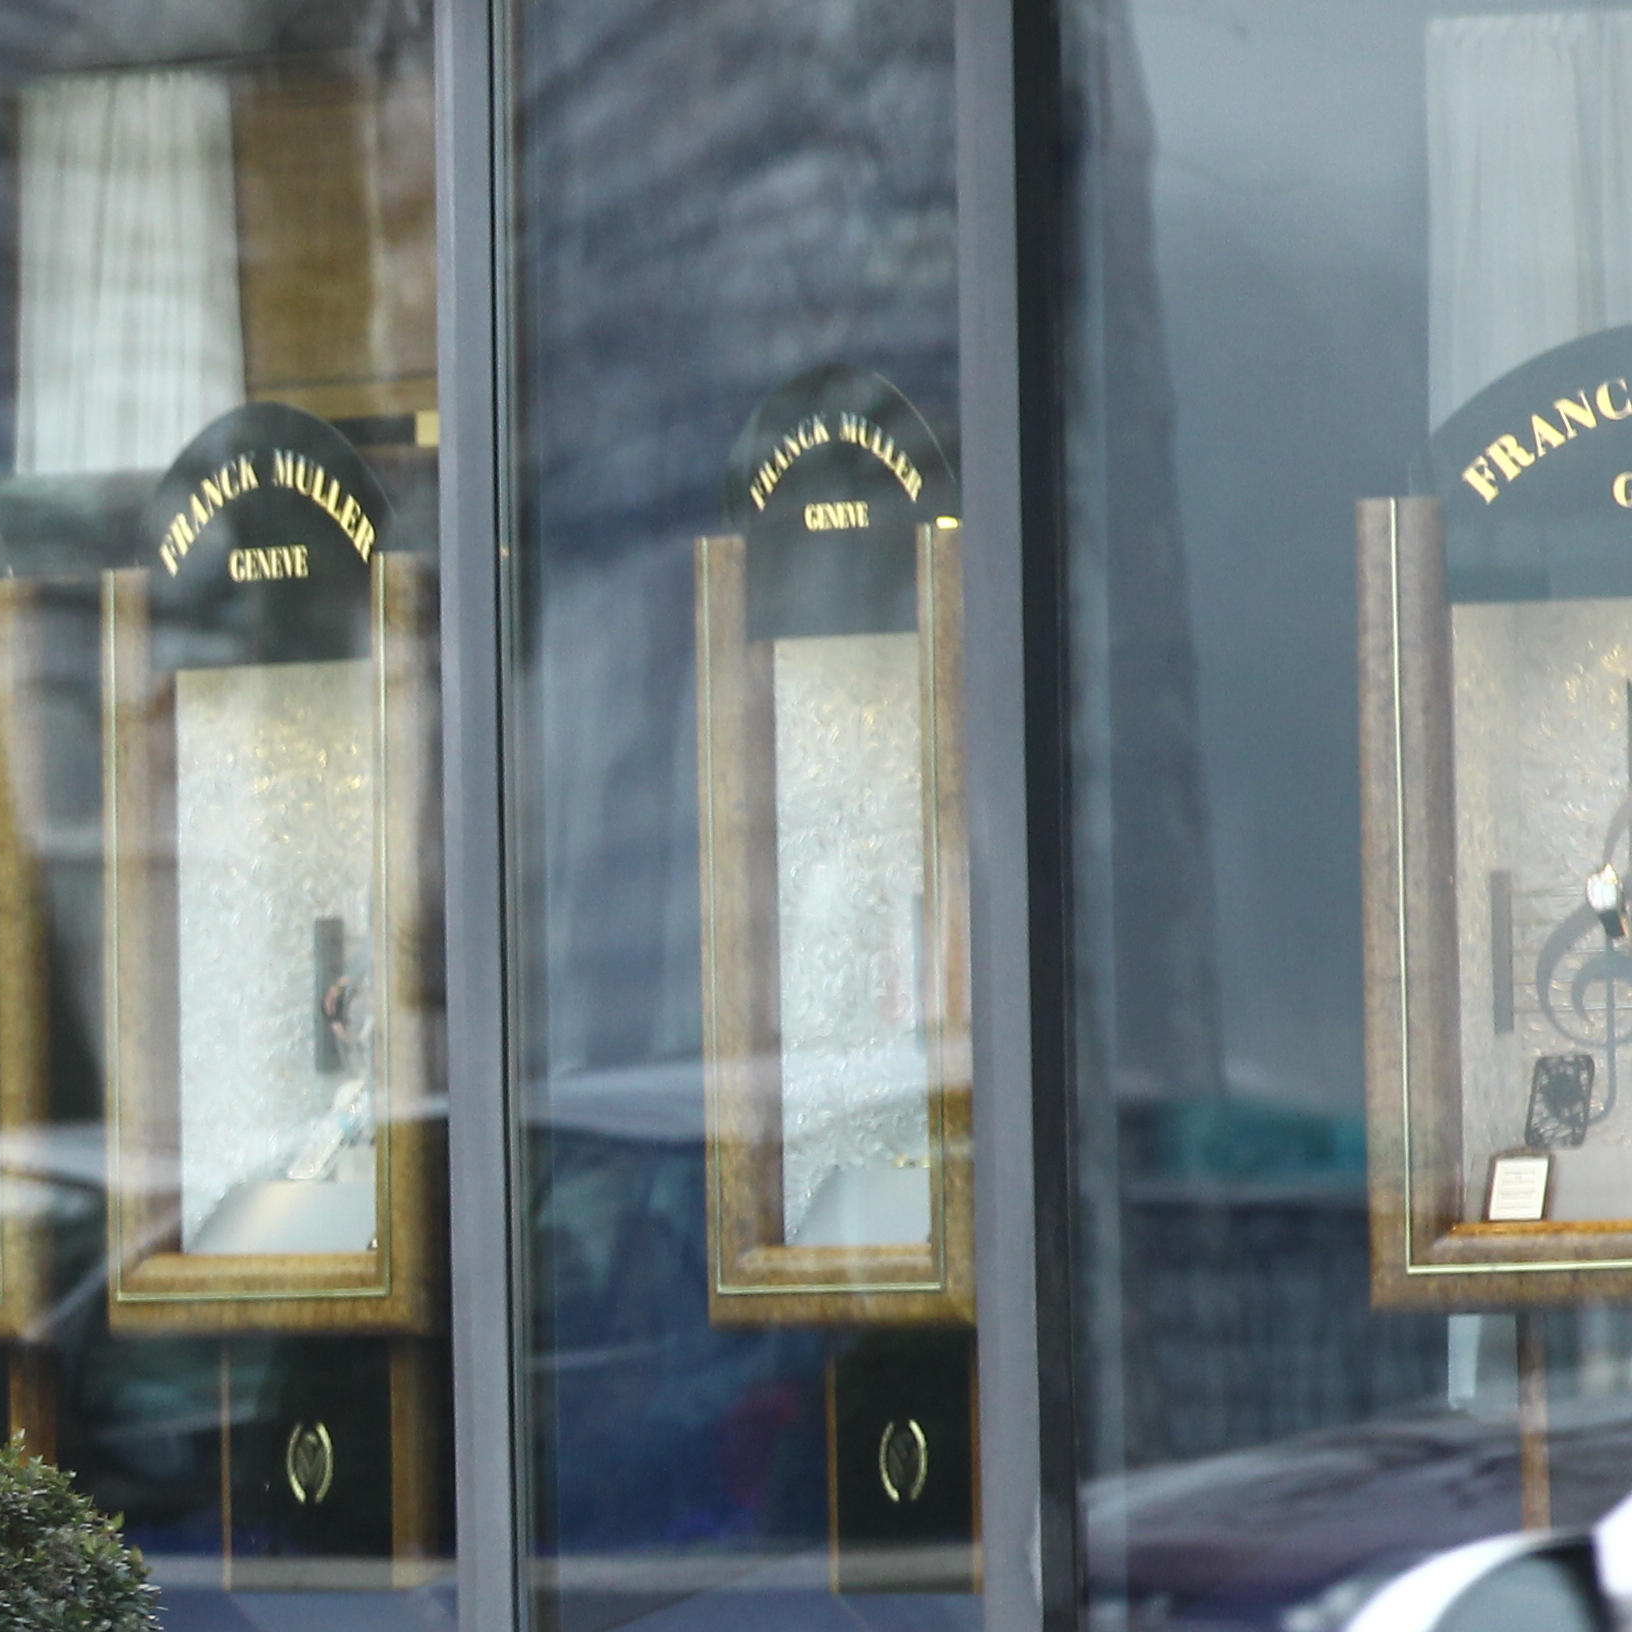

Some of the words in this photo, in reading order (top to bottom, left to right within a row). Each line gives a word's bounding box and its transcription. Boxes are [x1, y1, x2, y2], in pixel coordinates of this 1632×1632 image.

[839, 410, 924, 503] MULLER
[1462, 378, 1632, 505] FRANC
[160, 451, 259, 577] FRANCK
[272, 448, 377, 564] MULLER
[229, 544, 309, 582] GENEVE
